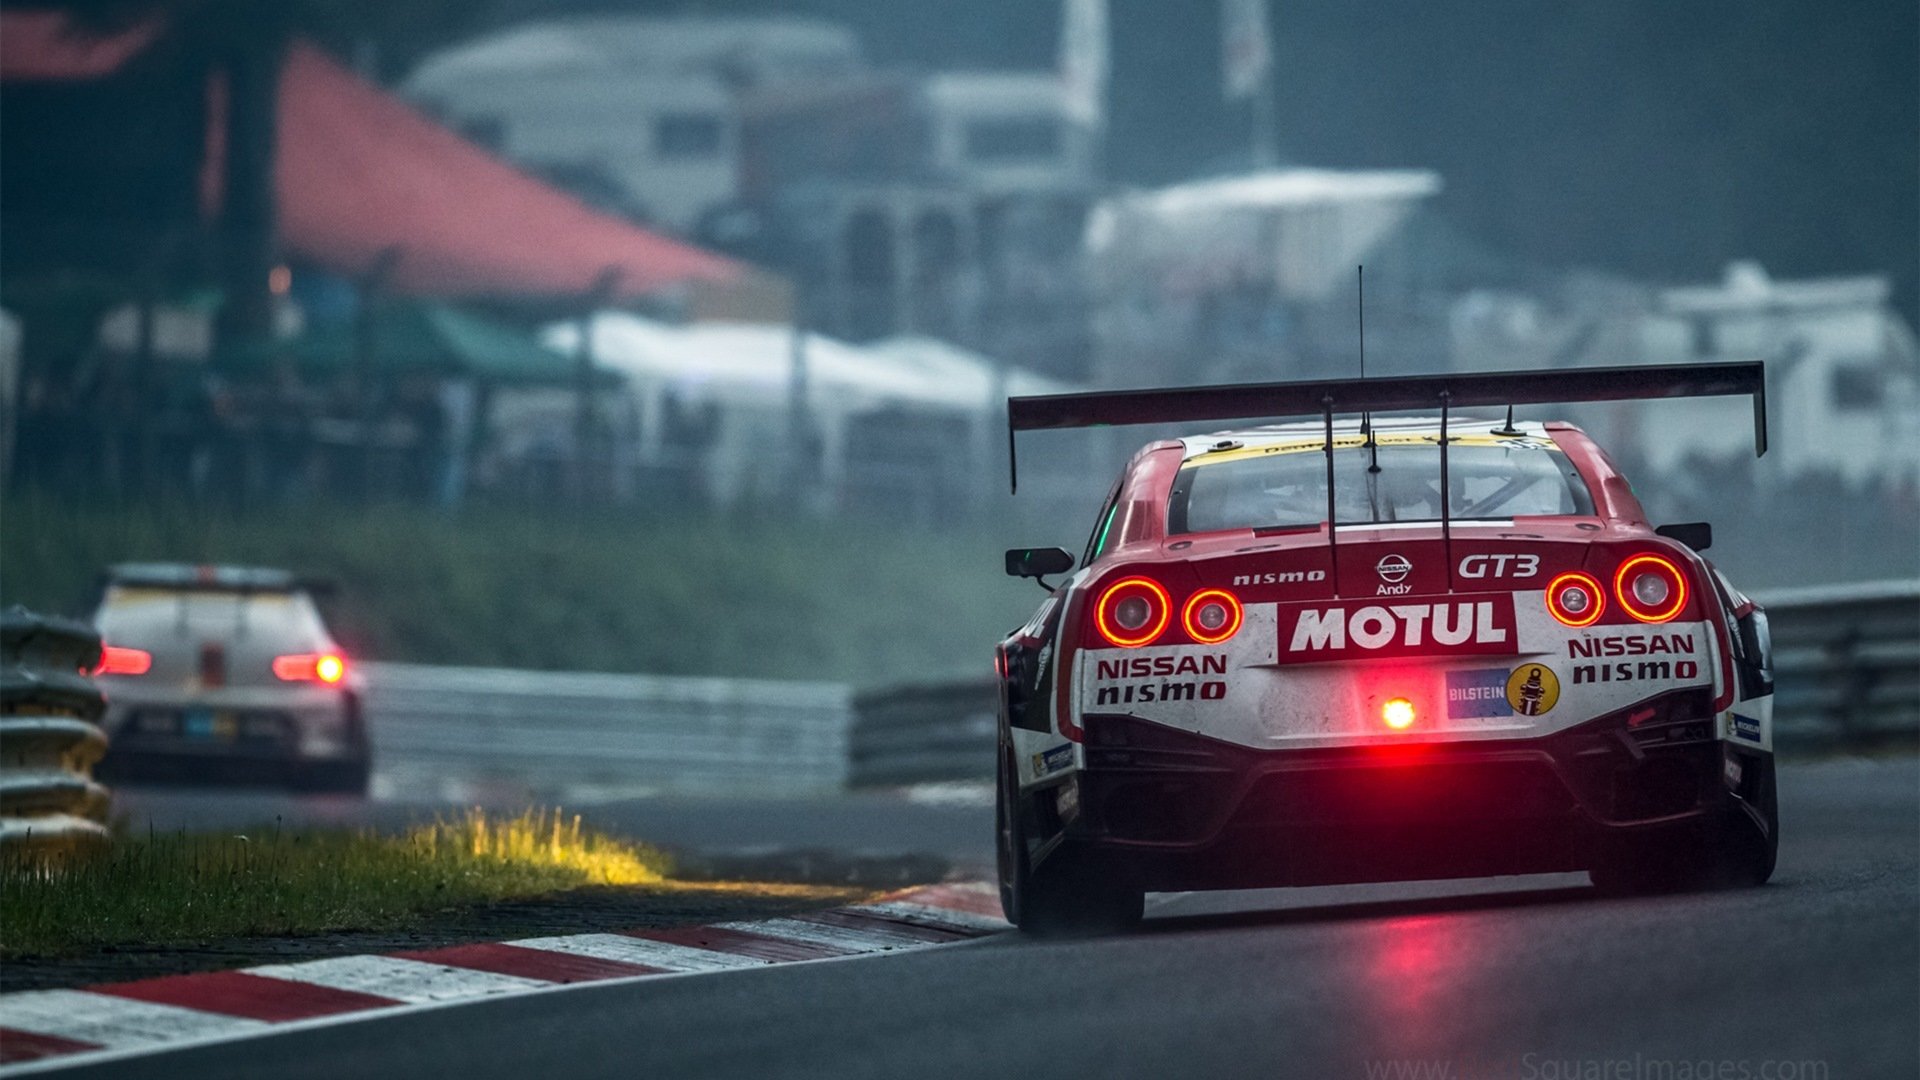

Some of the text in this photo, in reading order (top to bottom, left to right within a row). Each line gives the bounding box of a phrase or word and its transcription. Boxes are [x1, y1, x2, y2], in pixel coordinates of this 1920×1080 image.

[1233, 570, 1326, 586] nismo
[1458, 554, 1540, 579] GT3
[1376, 583, 1412, 596] Andy
[1290, 602, 1506, 651] MOTUL
[1569, 635, 1694, 658] NISSAN
[1098, 655, 1226, 679] NISSAN
[1572, 661, 1697, 683] nismo
[1096, 681, 1226, 705] nismo
[1448, 686, 1505, 701] BILSTEIN
